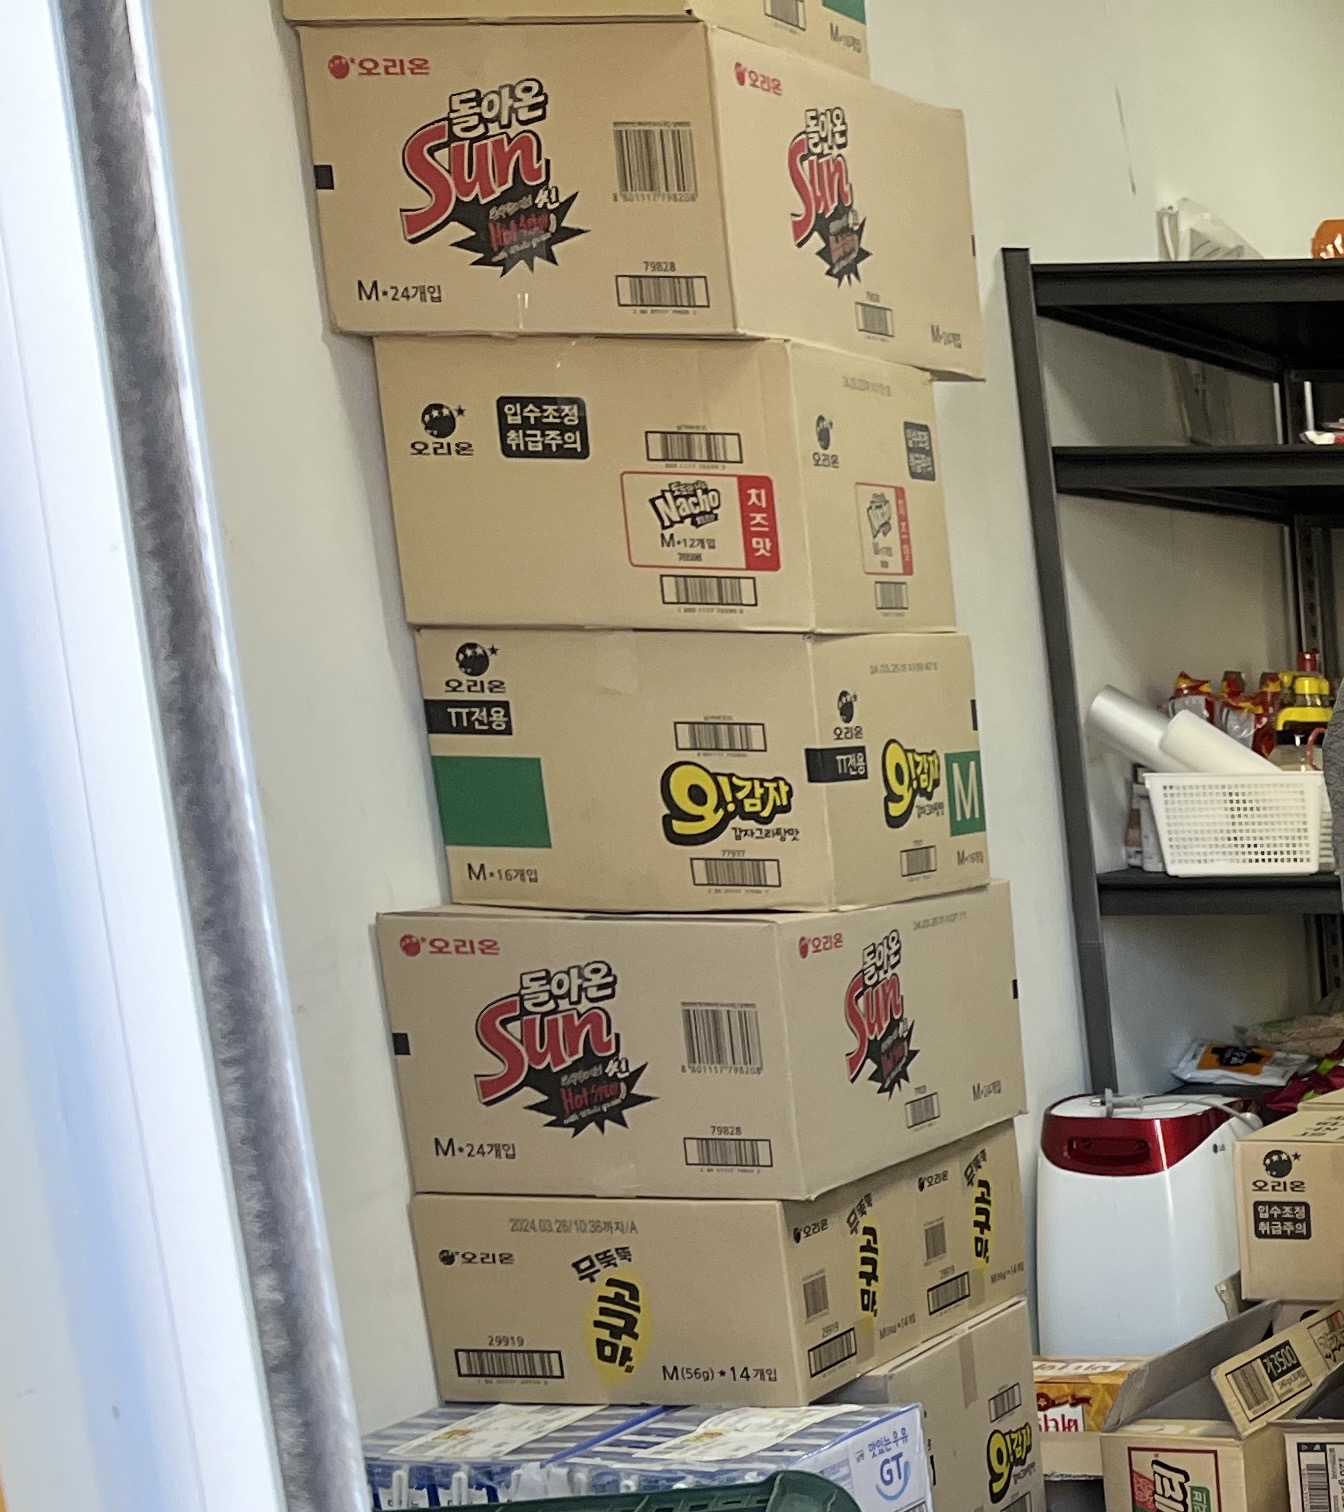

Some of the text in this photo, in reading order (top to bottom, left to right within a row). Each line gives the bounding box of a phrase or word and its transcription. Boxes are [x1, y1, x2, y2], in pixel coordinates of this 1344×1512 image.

[358, 57, 430, 76] 오리온
[748, 69, 783, 96] 오리온
[448, 78, 548, 139] 돌아온
[805, 107, 849, 155] 돌아온
[401, 119, 549, 244] Sun
[788, 130, 854, 248] Sun
[643, 261, 676, 272] 79828
[504, 403, 579, 425] 입수조정
[410, 441, 474, 456] 오리온
[507, 429, 582, 452] 취급주의
[649, 488, 720, 530] Nacho
[445, 679, 506, 693] 오리온
[447, 707, 508, 731] TT전용
[833, 725, 864, 740] 오리온
[952, 761, 980, 822] M
[429, 938, 500, 956] 오리온
[812, 933, 844, 953] 오리온
[863, 929, 901, 985] 돌아온
[520, 961, 617, 1013] 돌아온
[845, 969, 904, 1083] Sun
[475, 994, 621, 1106] Sun
[710, 1125, 742, 1136] 79828
[1252, 1180, 1306, 1192] 오리온
[1258, 1205, 1305, 1219] 입수조정
[802, 1218, 829, 1239] 오리온
[1258, 1222, 1306, 1235] 취급주의
[461, 1252, 515, 1264] 오리온
[571, 1246, 633, 1283] 무뚝뚝
[488, 1335, 525, 1348] 29919
[879, 1452, 904, 1487] GT
